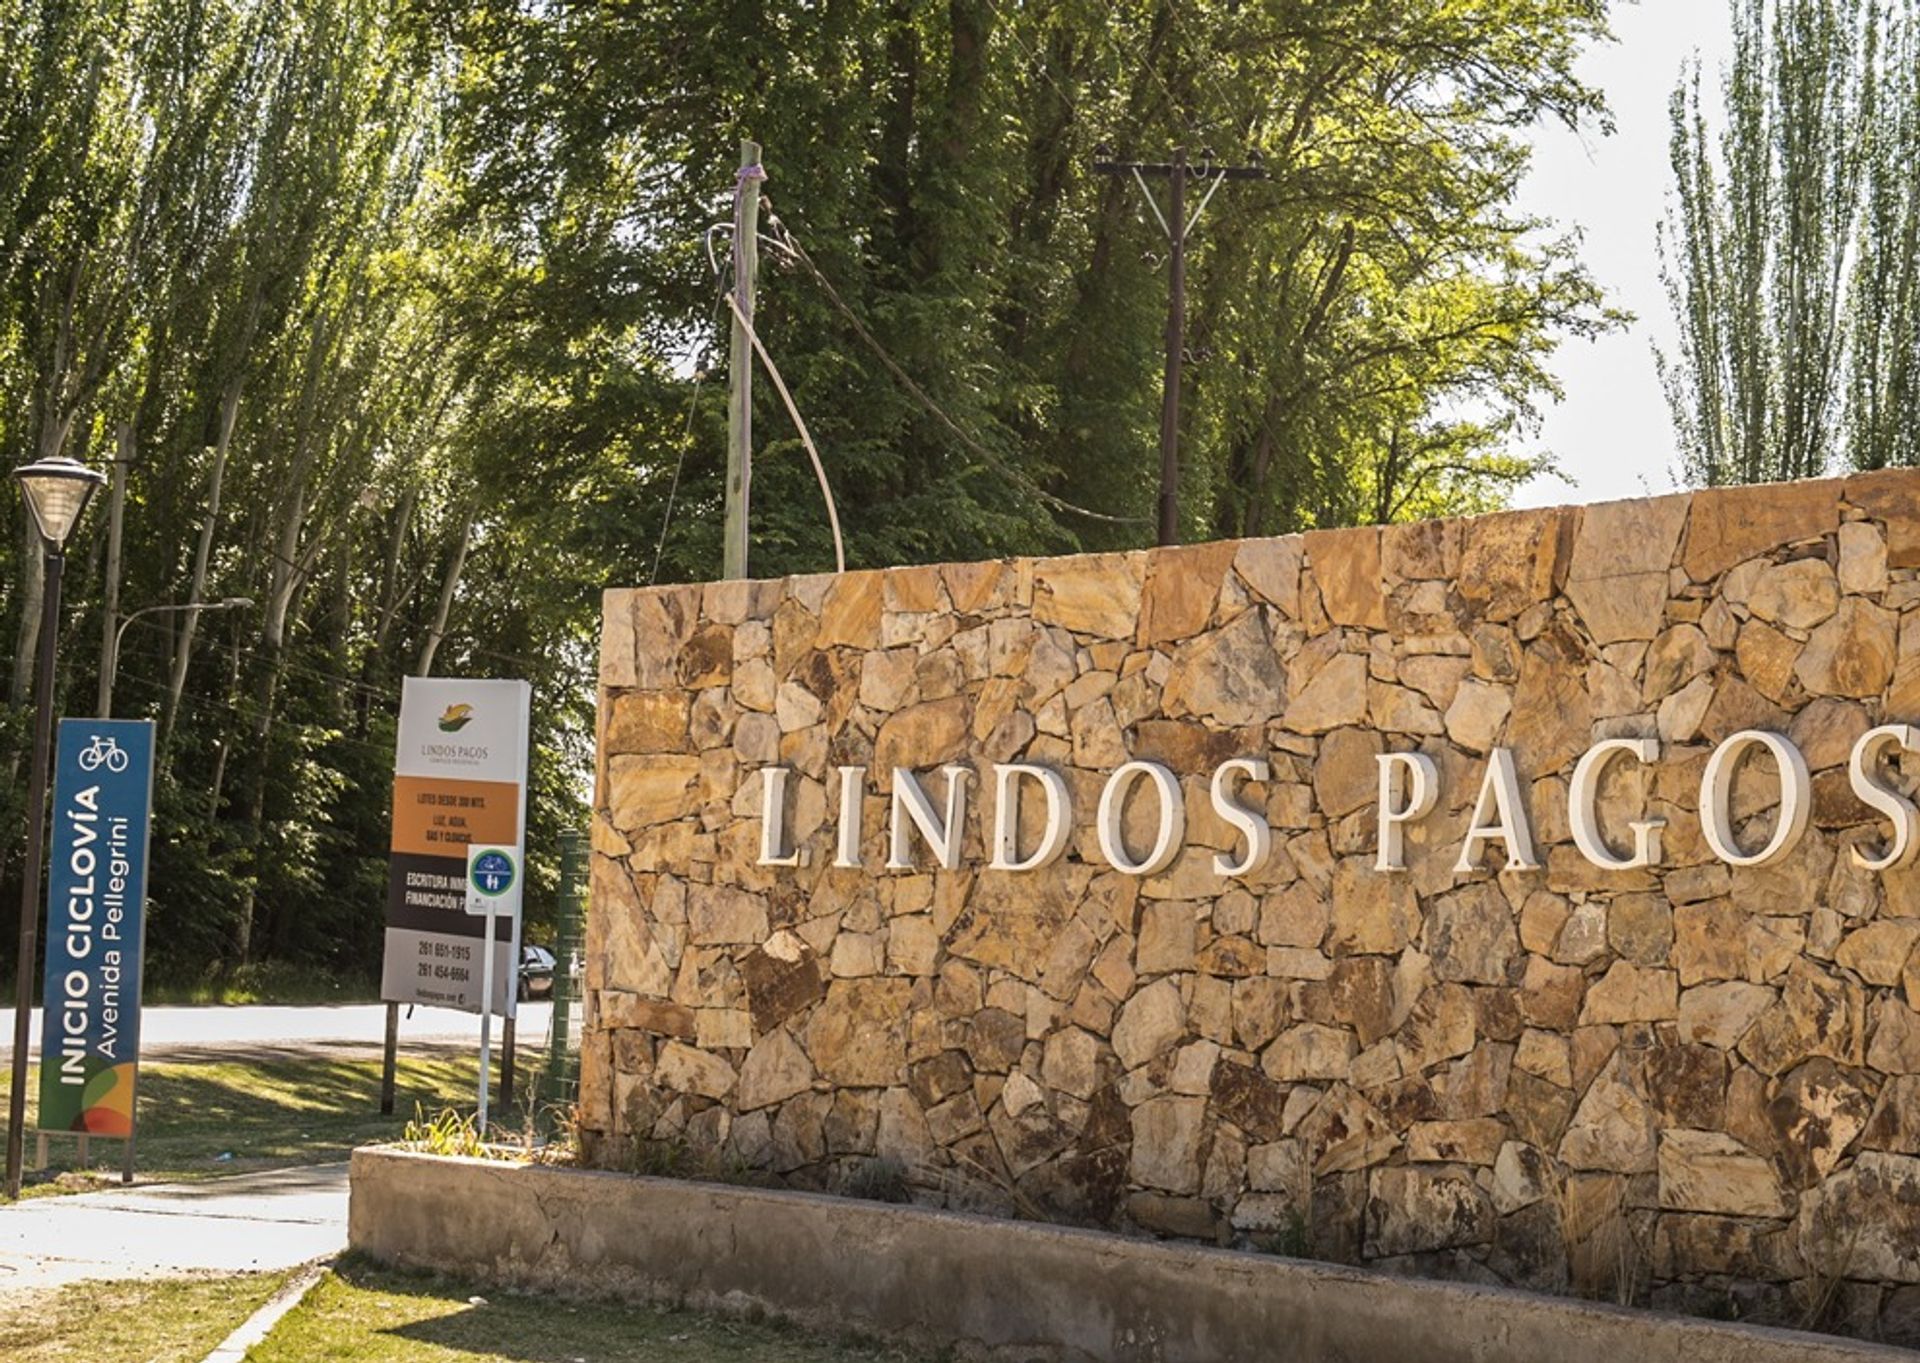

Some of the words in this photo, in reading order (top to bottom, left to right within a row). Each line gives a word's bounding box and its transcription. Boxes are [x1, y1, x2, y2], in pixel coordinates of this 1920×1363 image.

[421, 744, 456, 758] LINDOS
[458, 746, 488, 760] PAGOS
[757, 759, 1271, 876] LINDOS
[1374, 724, 1920, 872] PAGOS
[66, 785, 100, 959] CICLOVÍA
[102, 817, 129, 940] Pellegrini
[405, 891, 457, 909] FINANCIACIÓN
[406, 872, 448, 889] ESCRITURA
[418, 940, 432, 956] 261
[418, 962, 432, 977] 261
[60, 970, 90, 1085] INICIO
[97, 950, 121, 1059] Avenida
